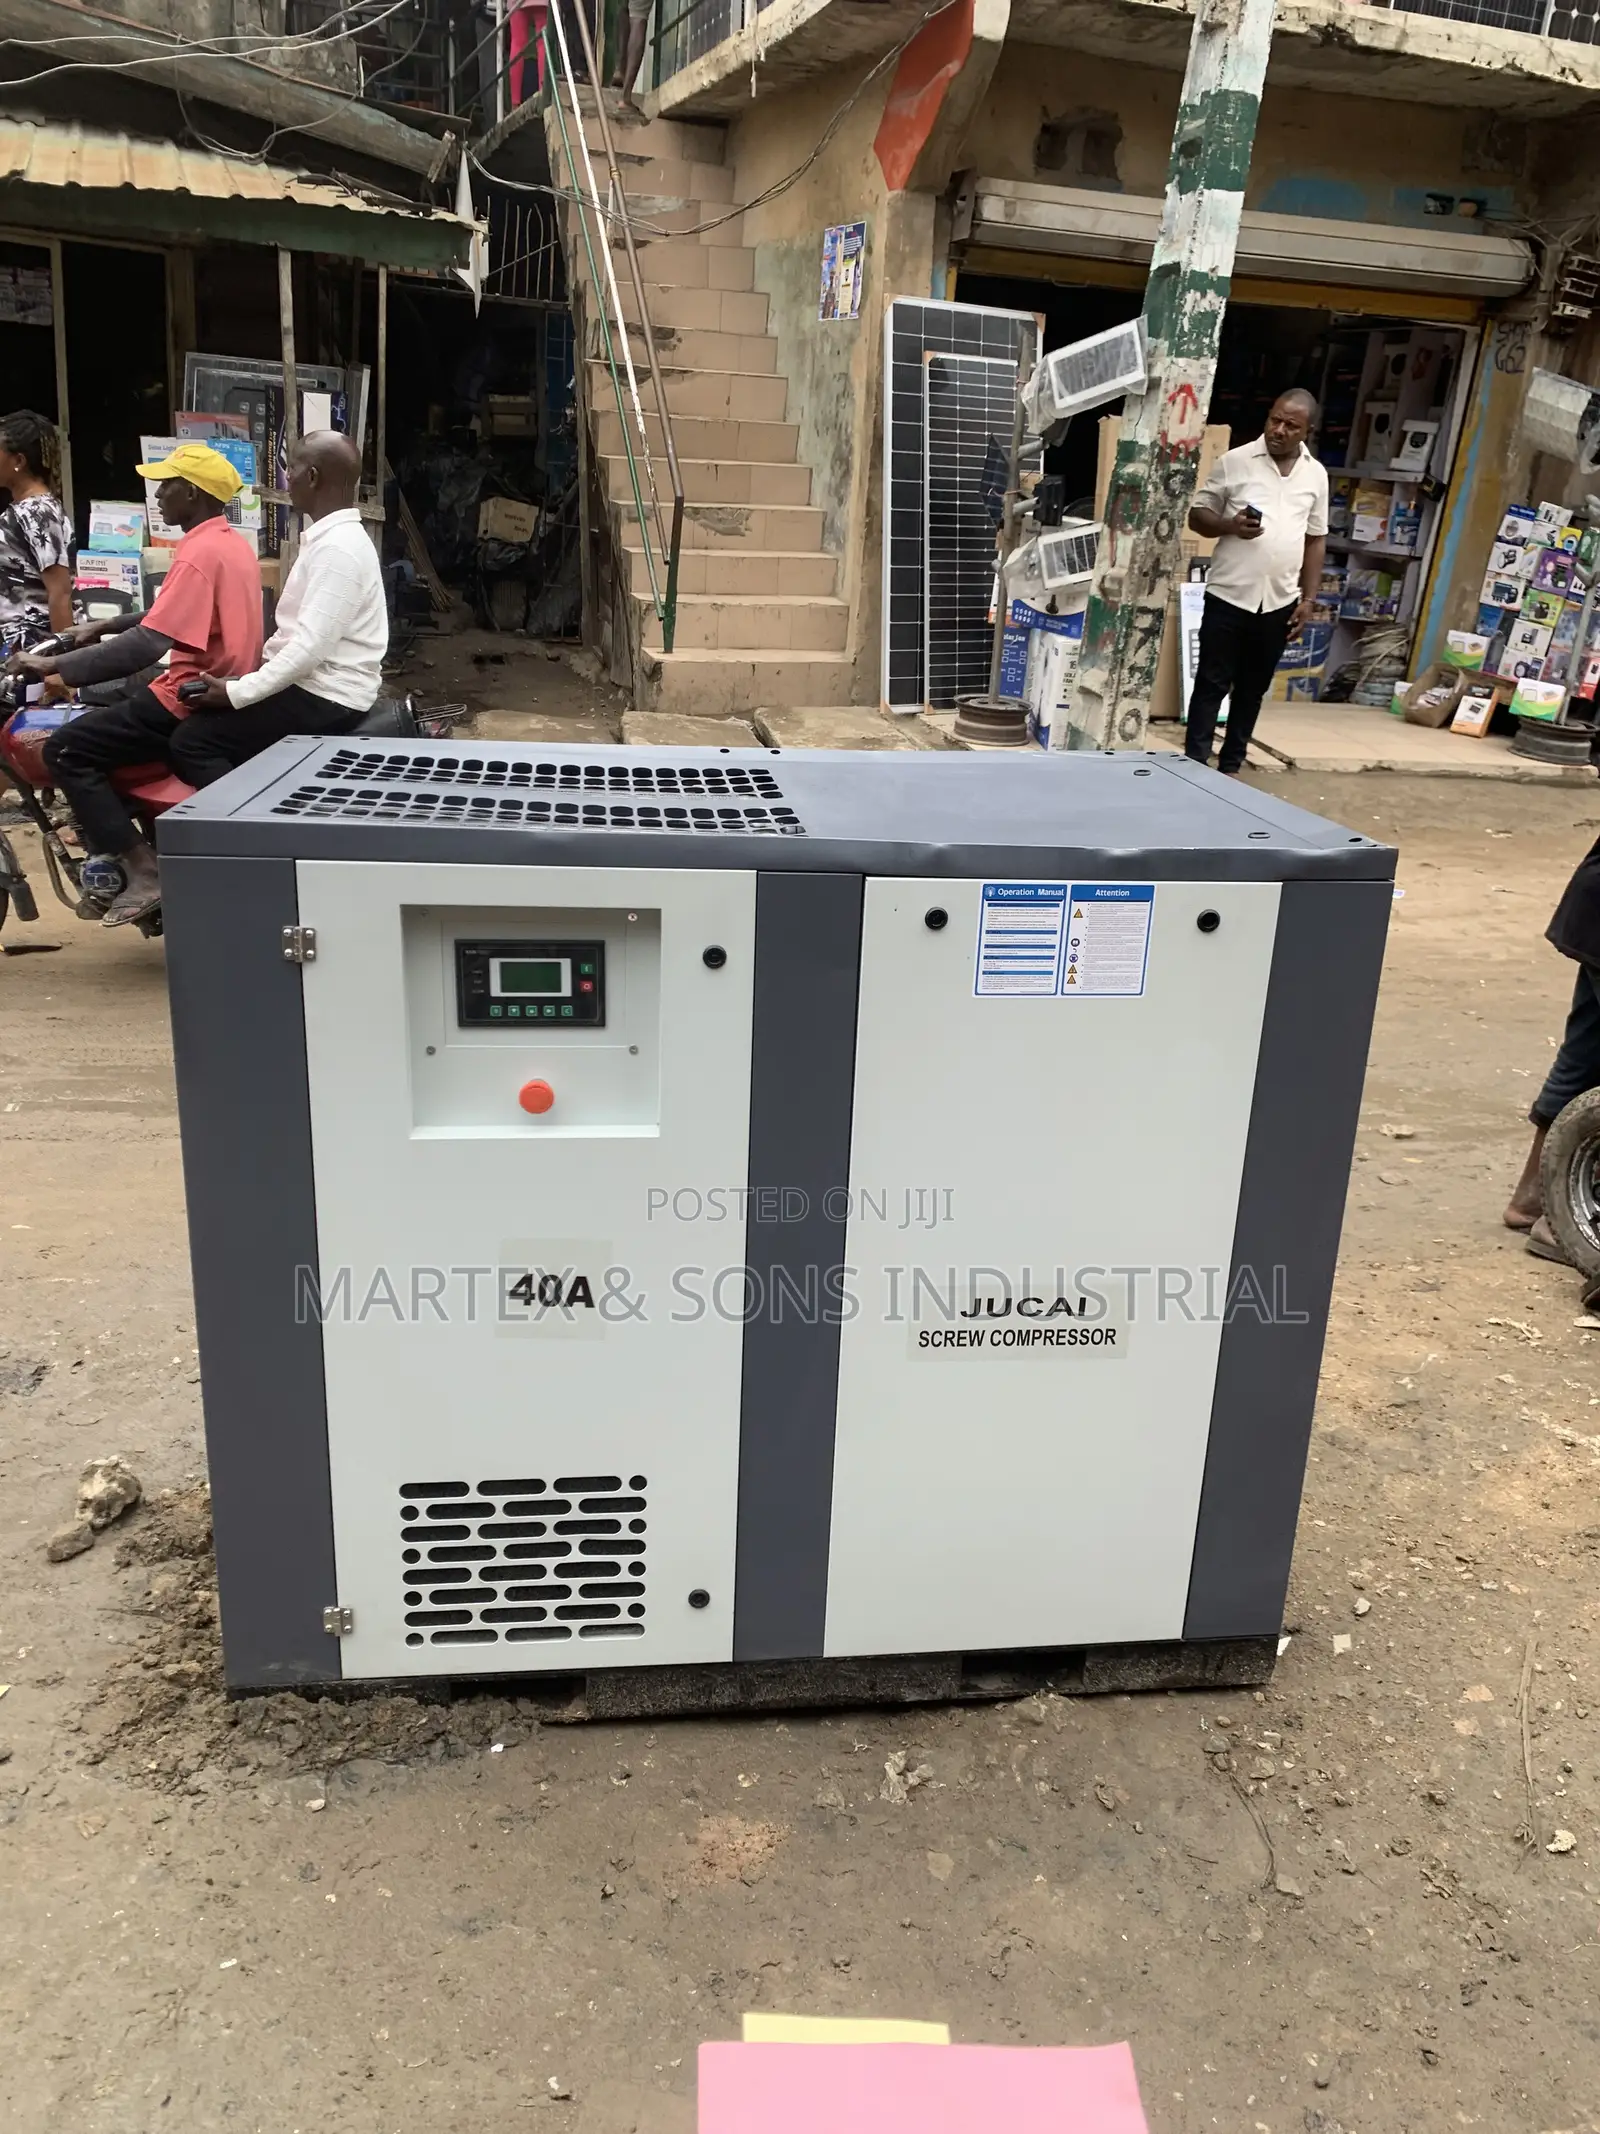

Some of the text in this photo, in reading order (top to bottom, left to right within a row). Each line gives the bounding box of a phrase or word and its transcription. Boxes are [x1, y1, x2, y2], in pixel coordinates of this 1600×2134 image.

[997, 887, 1065, 897] Operation Manual
[1095, 888, 1130, 897] Attention
[508, 1273, 596, 1309] 40A
[960, 1297, 1088, 1318] JUCAI
[918, 1328, 1117, 1348] SCREW COMPRESSOR
